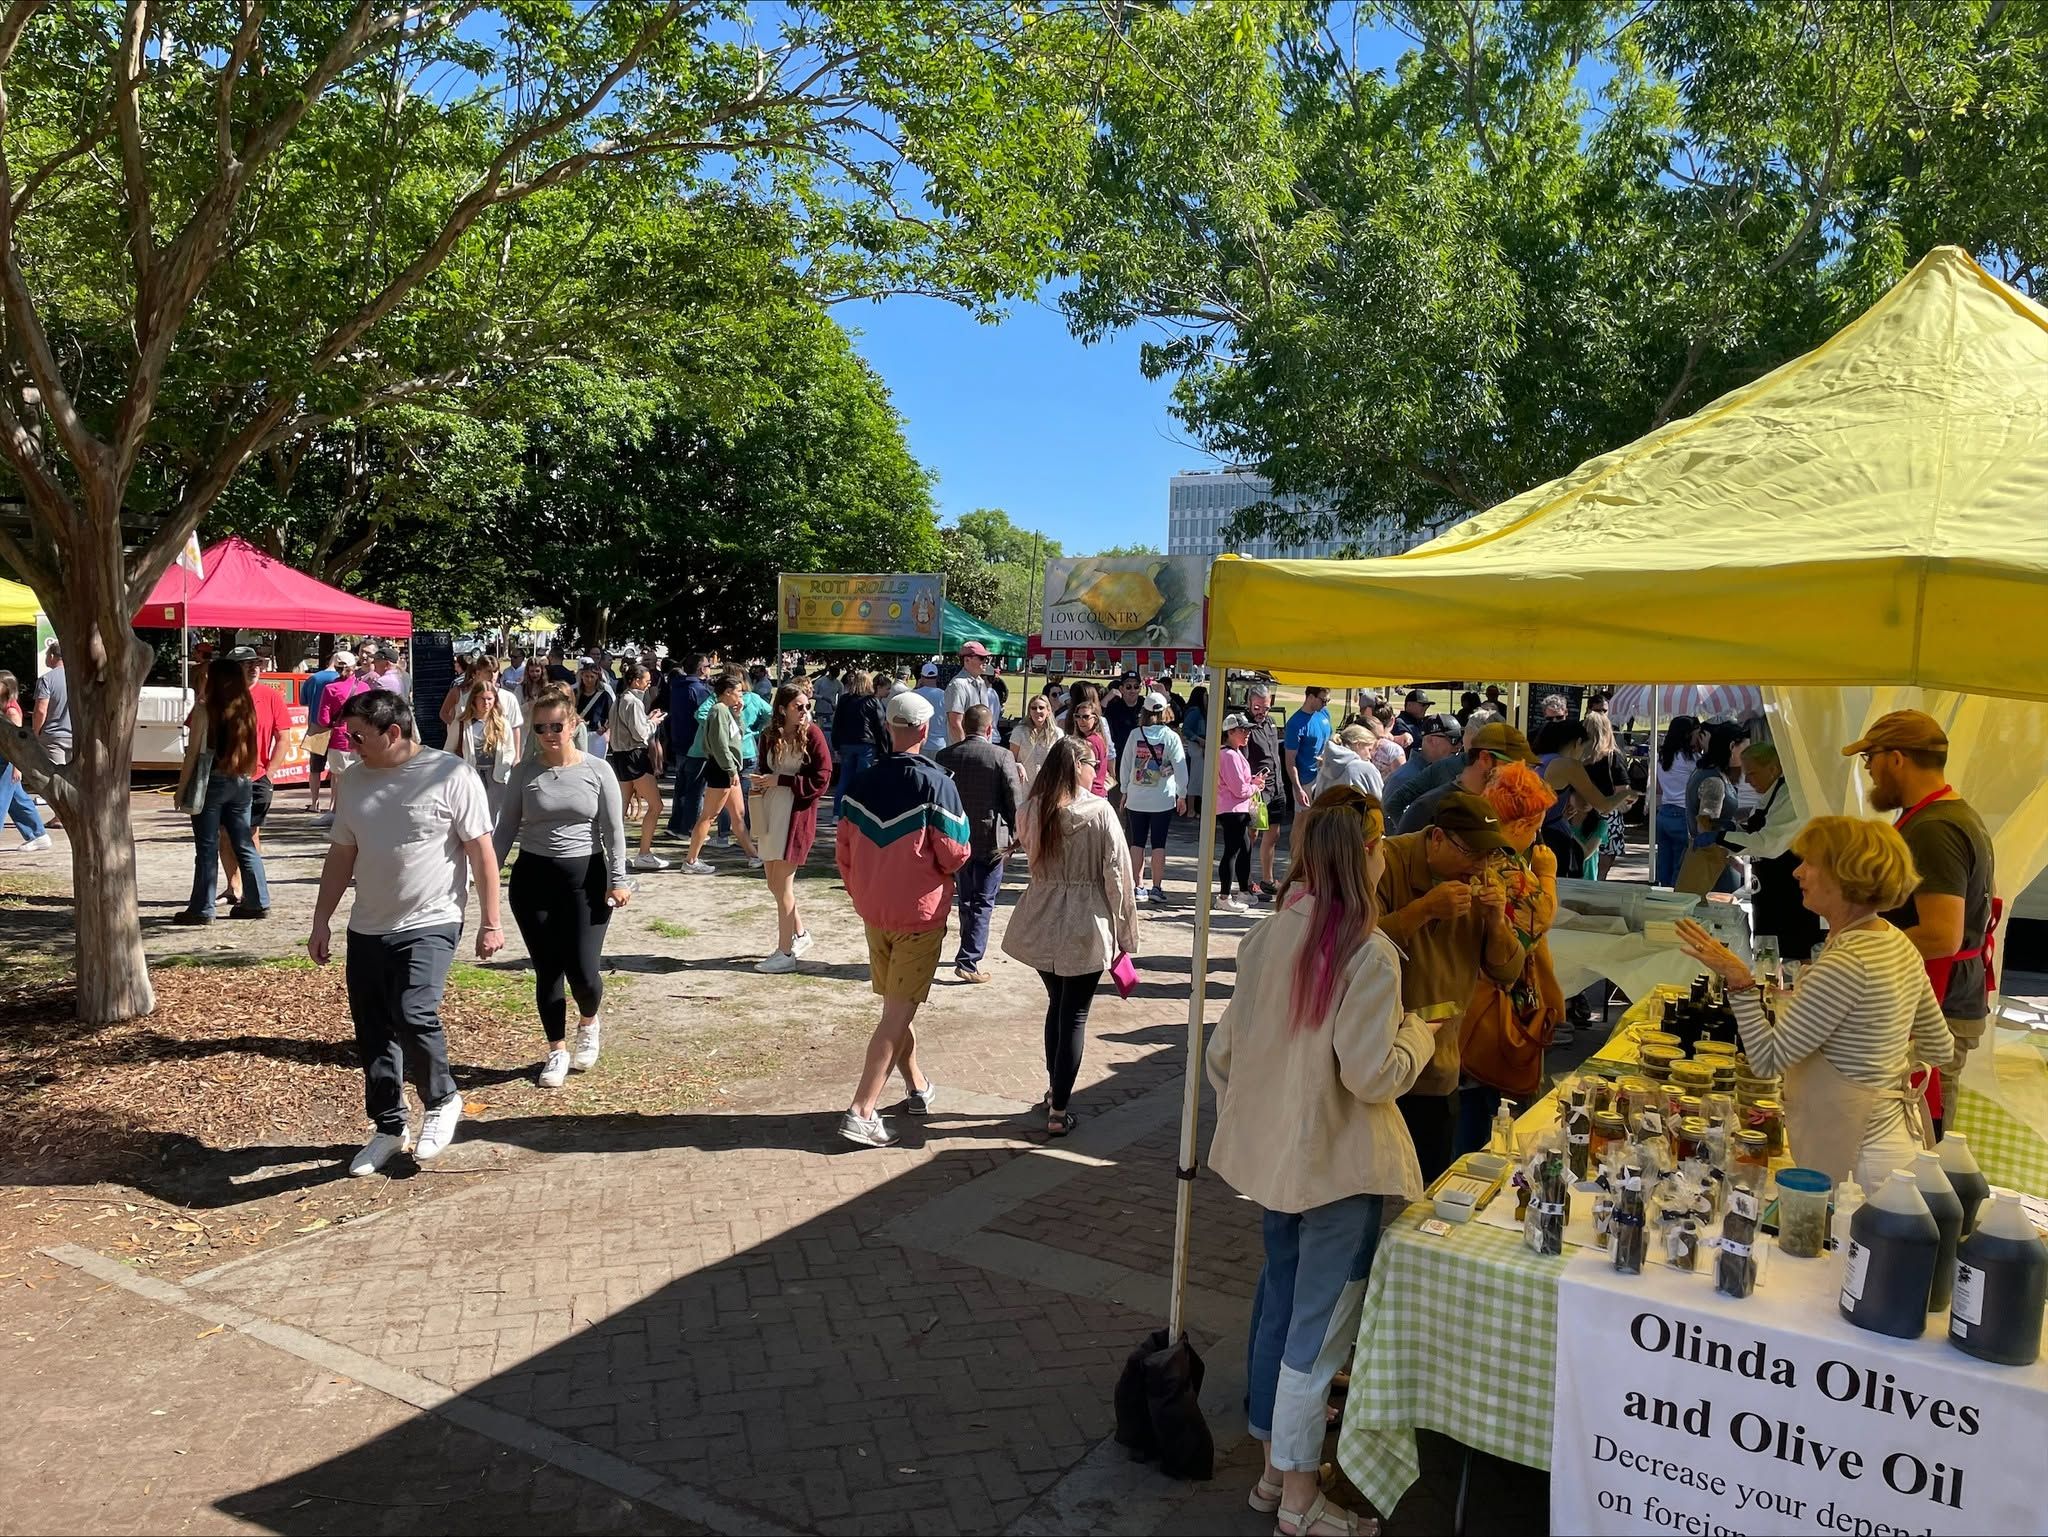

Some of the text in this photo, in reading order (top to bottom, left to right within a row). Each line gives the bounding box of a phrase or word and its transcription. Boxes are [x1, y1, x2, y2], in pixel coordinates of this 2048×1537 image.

[810, 580, 910, 594] ROTI ROLLS
[1050, 629, 1121, 641] LEMONADE
[1629, 1312, 1981, 1437] Olinda Olives
[1592, 1434, 1727, 1497] Decrease
[1734, 1483, 1807, 1521] your
[1623, 1391, 1964, 1510] and Olive Oil
[1597, 1489, 1634, 1516] on
